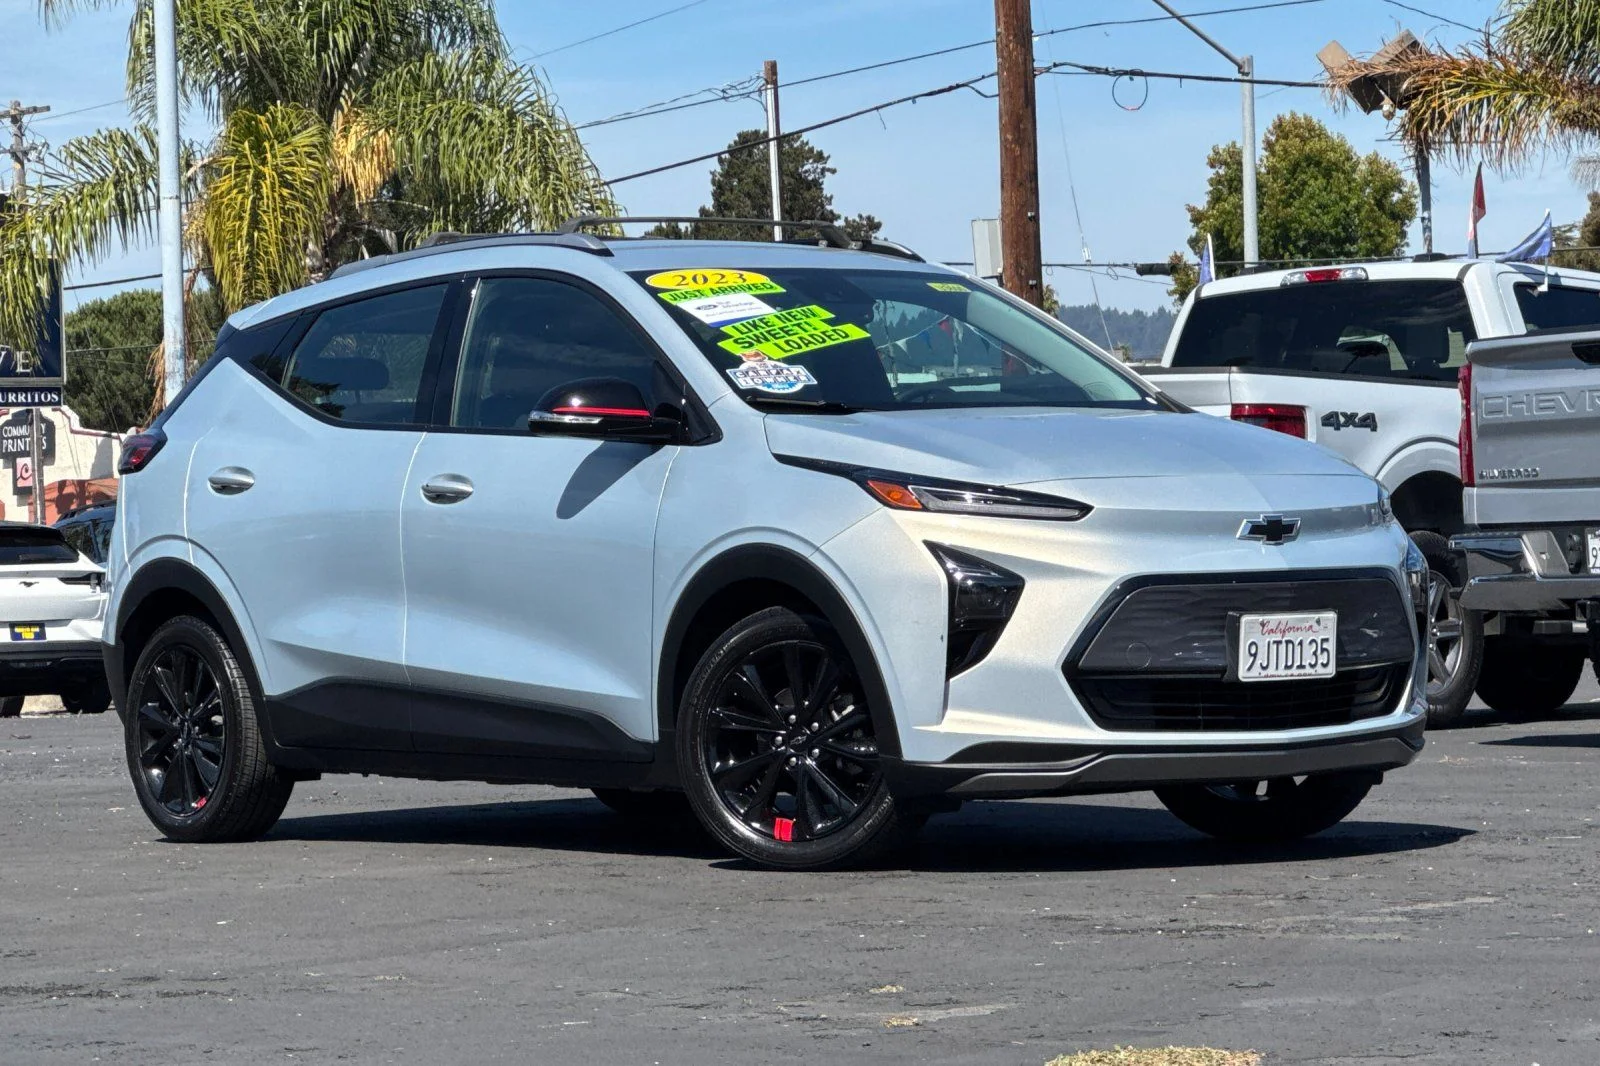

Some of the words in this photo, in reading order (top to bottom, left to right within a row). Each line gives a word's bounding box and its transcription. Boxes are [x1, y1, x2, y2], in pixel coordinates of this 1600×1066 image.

[672, 272, 747, 286] 2023
[668, 287, 706, 301] JUST
[709, 282, 774, 295] ARRIVED
[732, 317, 771, 335] LIKE
[780, 307, 817, 324] NEW
[733, 322, 816, 348] SWEET!
[774, 328, 850, 353] LOADED
[2, 423, 47, 437] COMMUY
[1320, 411, 1378, 432] 4x4
[2, 437, 47, 453] PRINTS
[1260, 619, 1319, 639] California
[1246, 637, 1330, 671] 9JTD135
